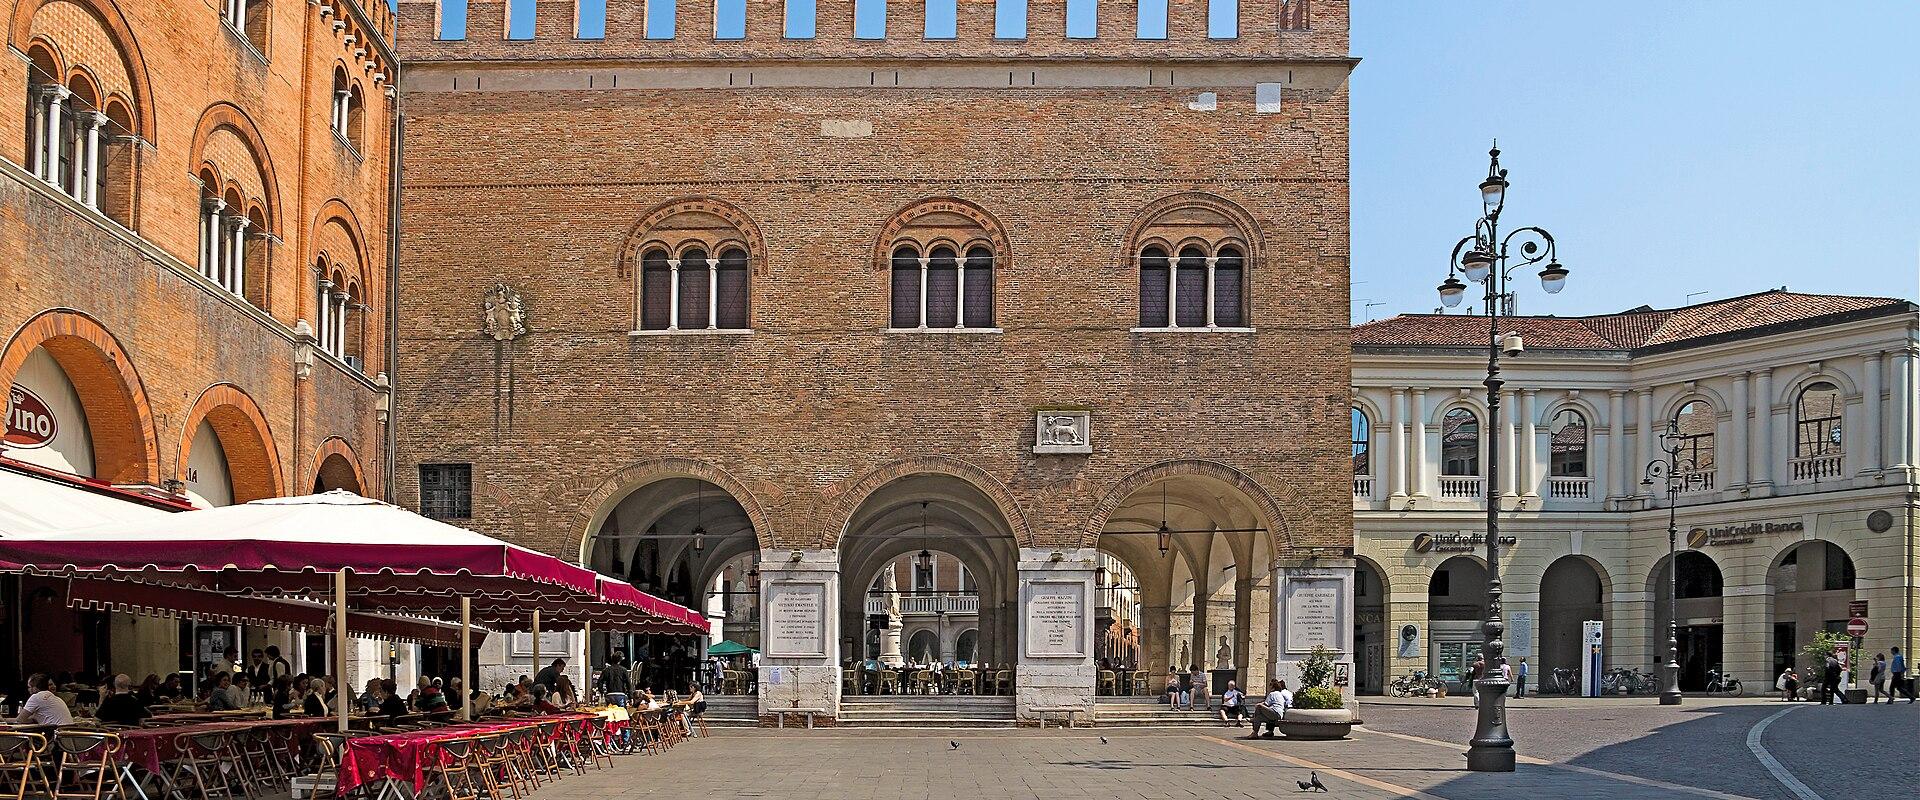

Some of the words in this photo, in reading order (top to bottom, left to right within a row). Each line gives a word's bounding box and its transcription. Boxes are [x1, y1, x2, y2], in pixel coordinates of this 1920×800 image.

[1710, 523, 1763, 538] UniCredit
[1764, 521, 1804, 534] Banca
[1435, 531, 1485, 545] UniCredit
